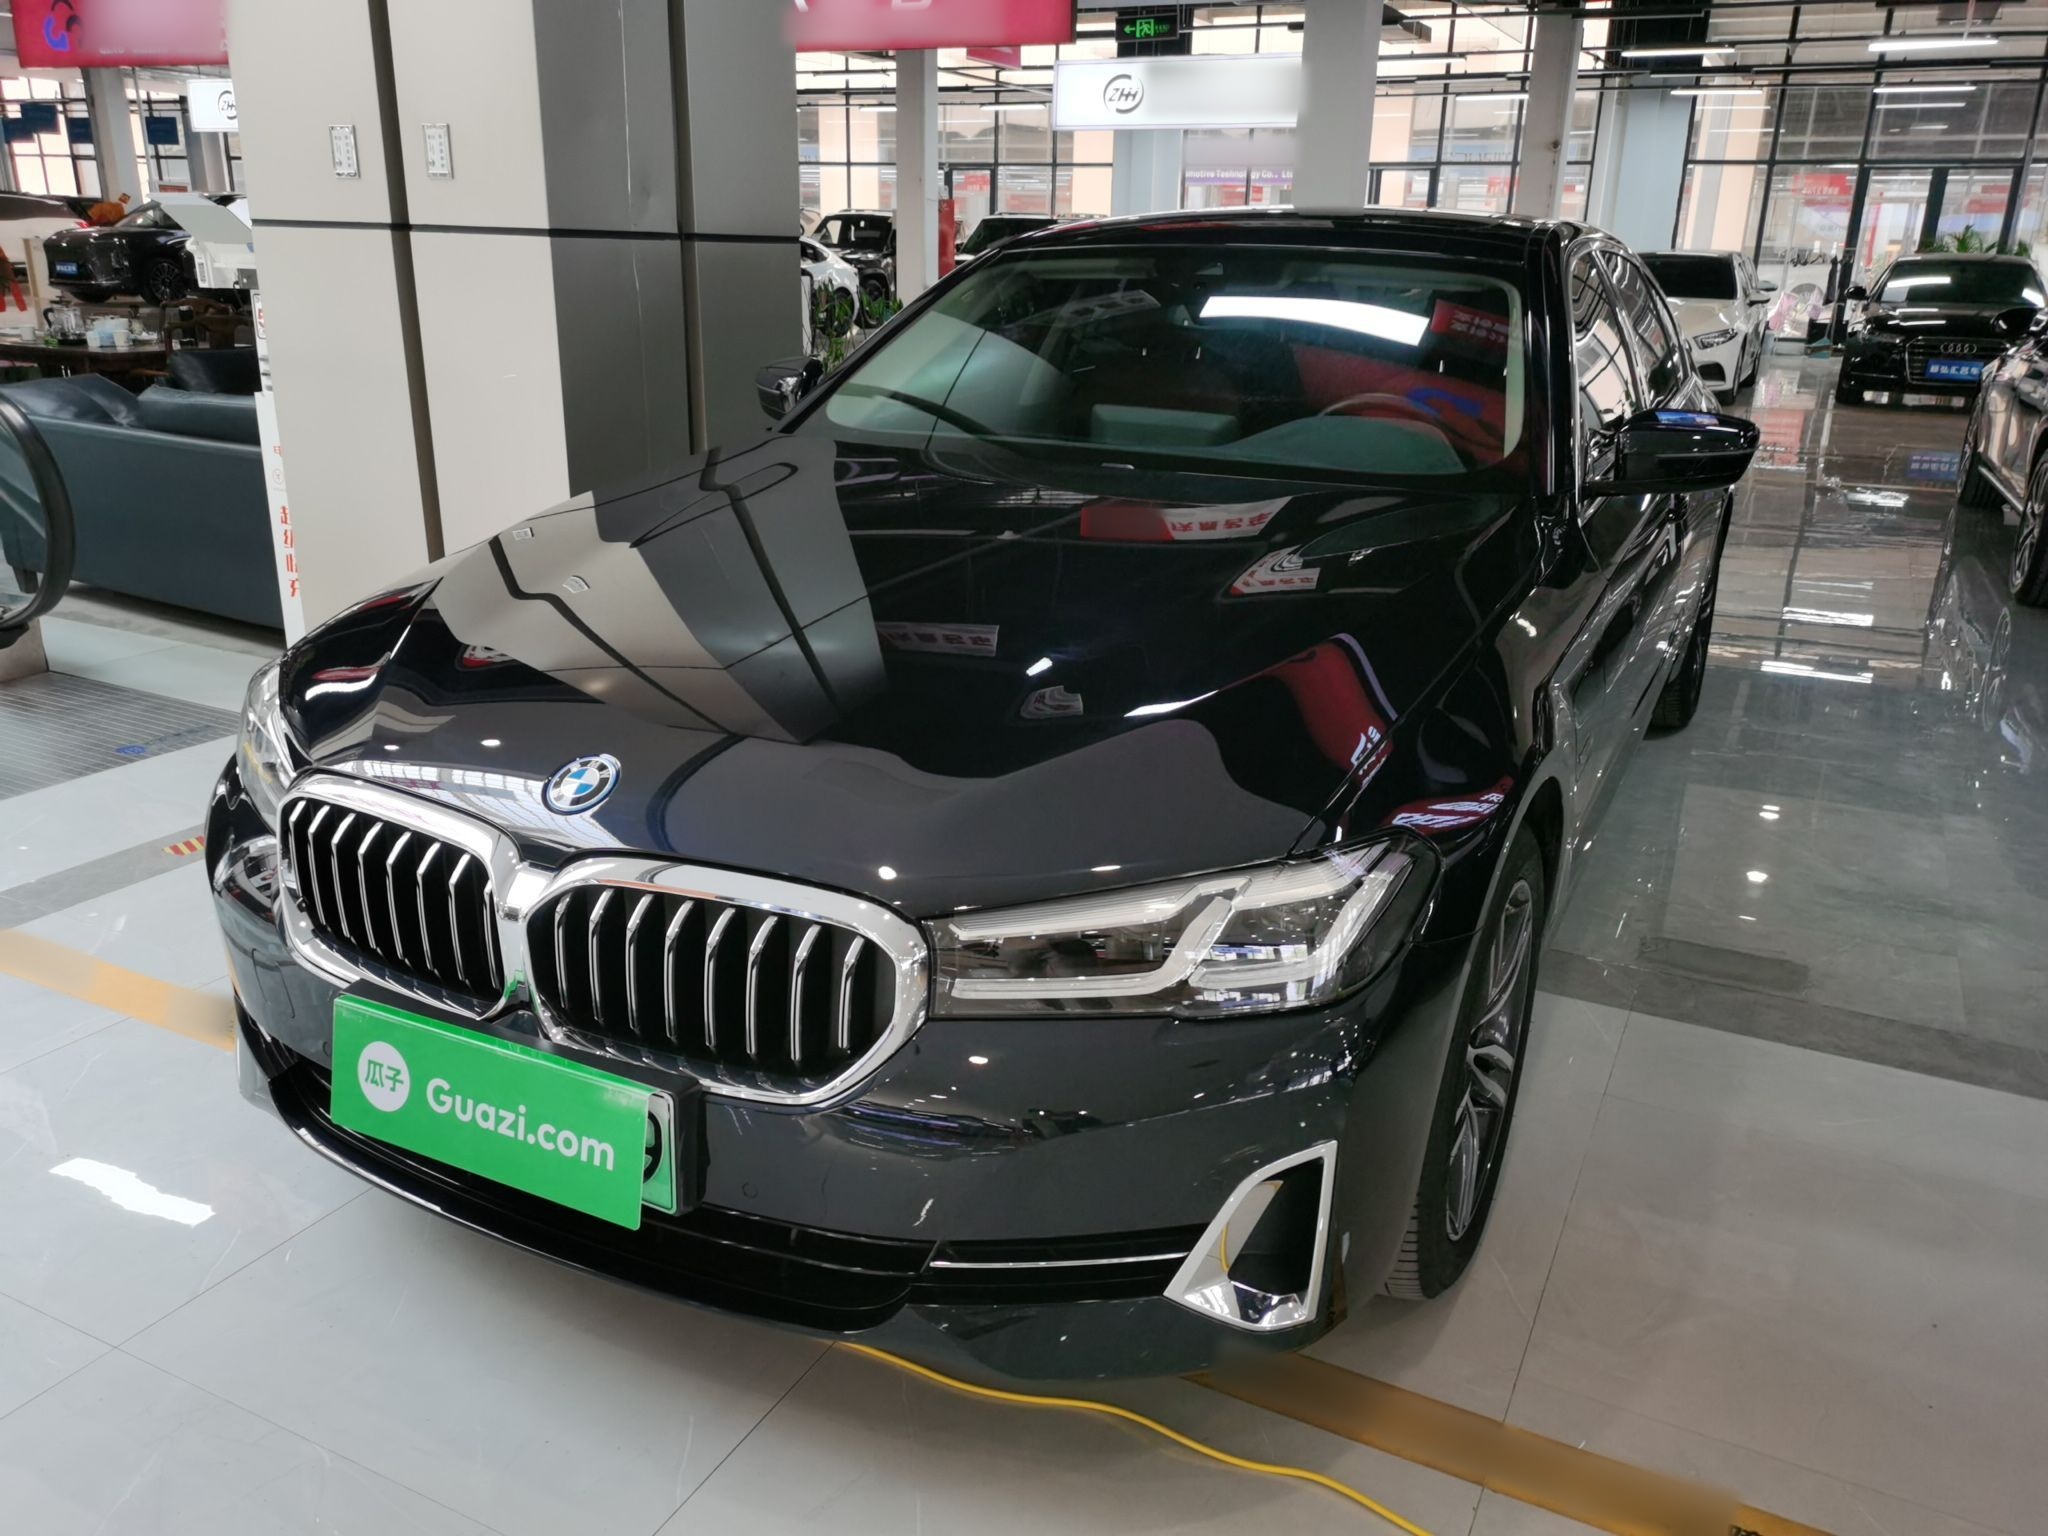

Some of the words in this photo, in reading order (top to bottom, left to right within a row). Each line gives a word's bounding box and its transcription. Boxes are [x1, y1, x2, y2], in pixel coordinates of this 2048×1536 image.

[1216, 169, 1260, 180] Technolgy
[364, 1059, 405, 1092] 瓜子
[426, 1078, 615, 1171] Guazi.com
